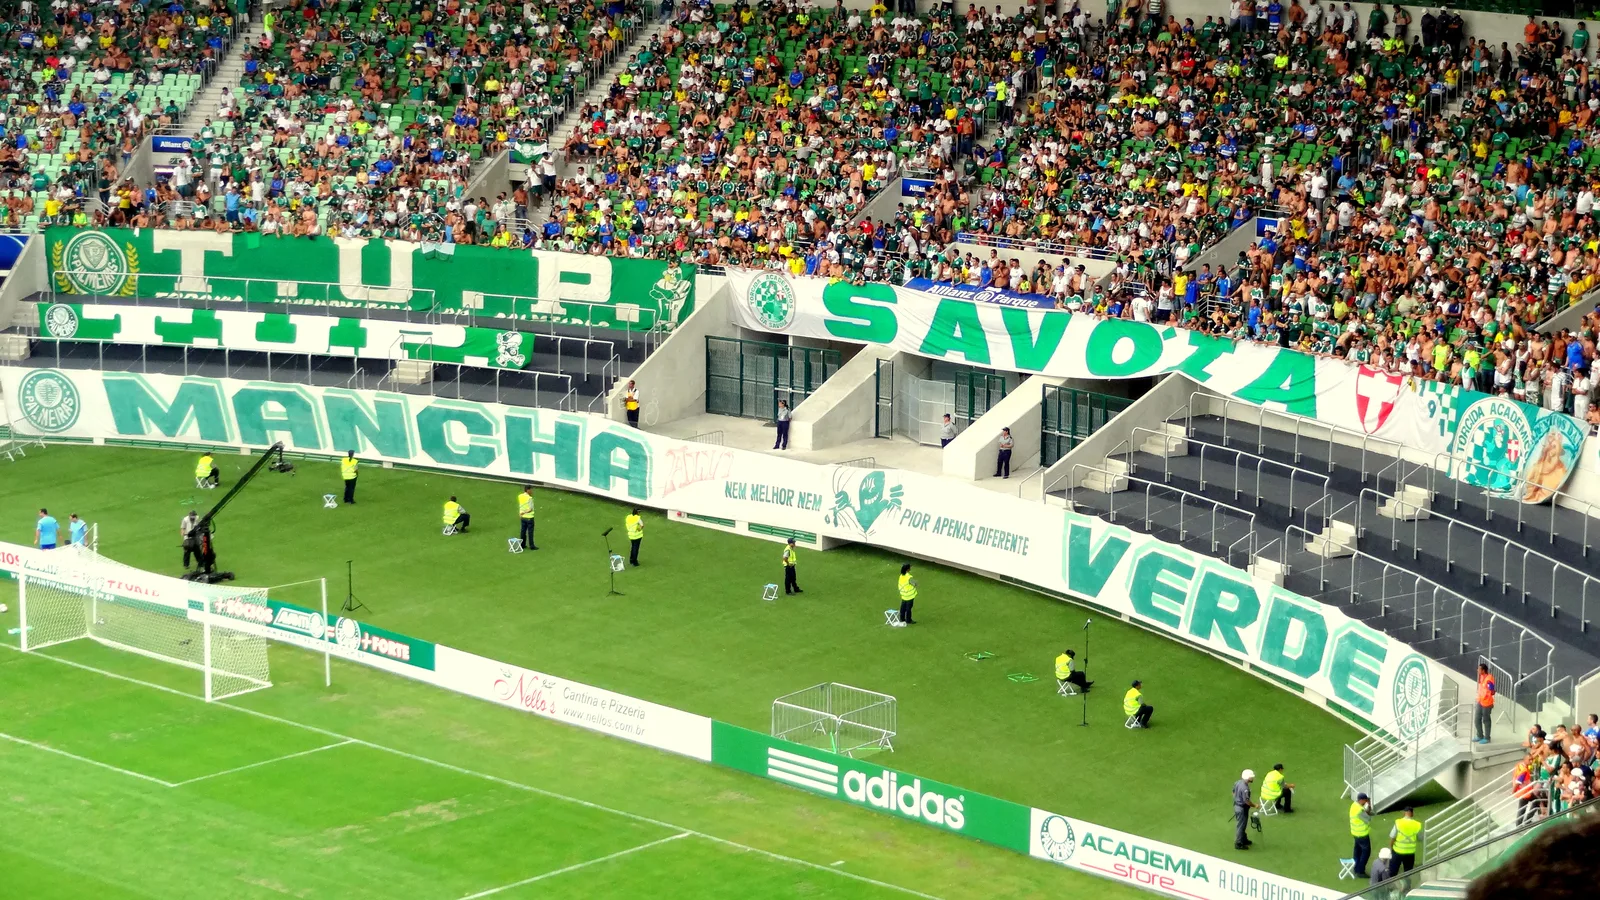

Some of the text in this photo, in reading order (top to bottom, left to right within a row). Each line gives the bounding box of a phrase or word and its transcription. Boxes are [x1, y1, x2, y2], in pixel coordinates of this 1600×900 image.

[925, 284, 1039, 308] Allianz Parque
[25, 395, 74, 427] PALMEIRAS
[102, 371, 653, 501] MANCHA
[1456, 405, 1485, 453] TORCIDA
[725, 481, 823, 511] NEM MELHOR NEM
[900, 508, 1030, 556] PIOR APENAS DIFERENTE
[1062, 511, 1388, 716] VERDE
[563, 686, 646, 720] Cantina e Pizzeria
[563, 706, 645, 737] www.nellos.com.br
[1080, 832, 1210, 883] ACADEMIA
[1113, 862, 1175, 888] store
[1219, 869, 1227, 889] A
[1230, 872, 1258, 898] LOJA
